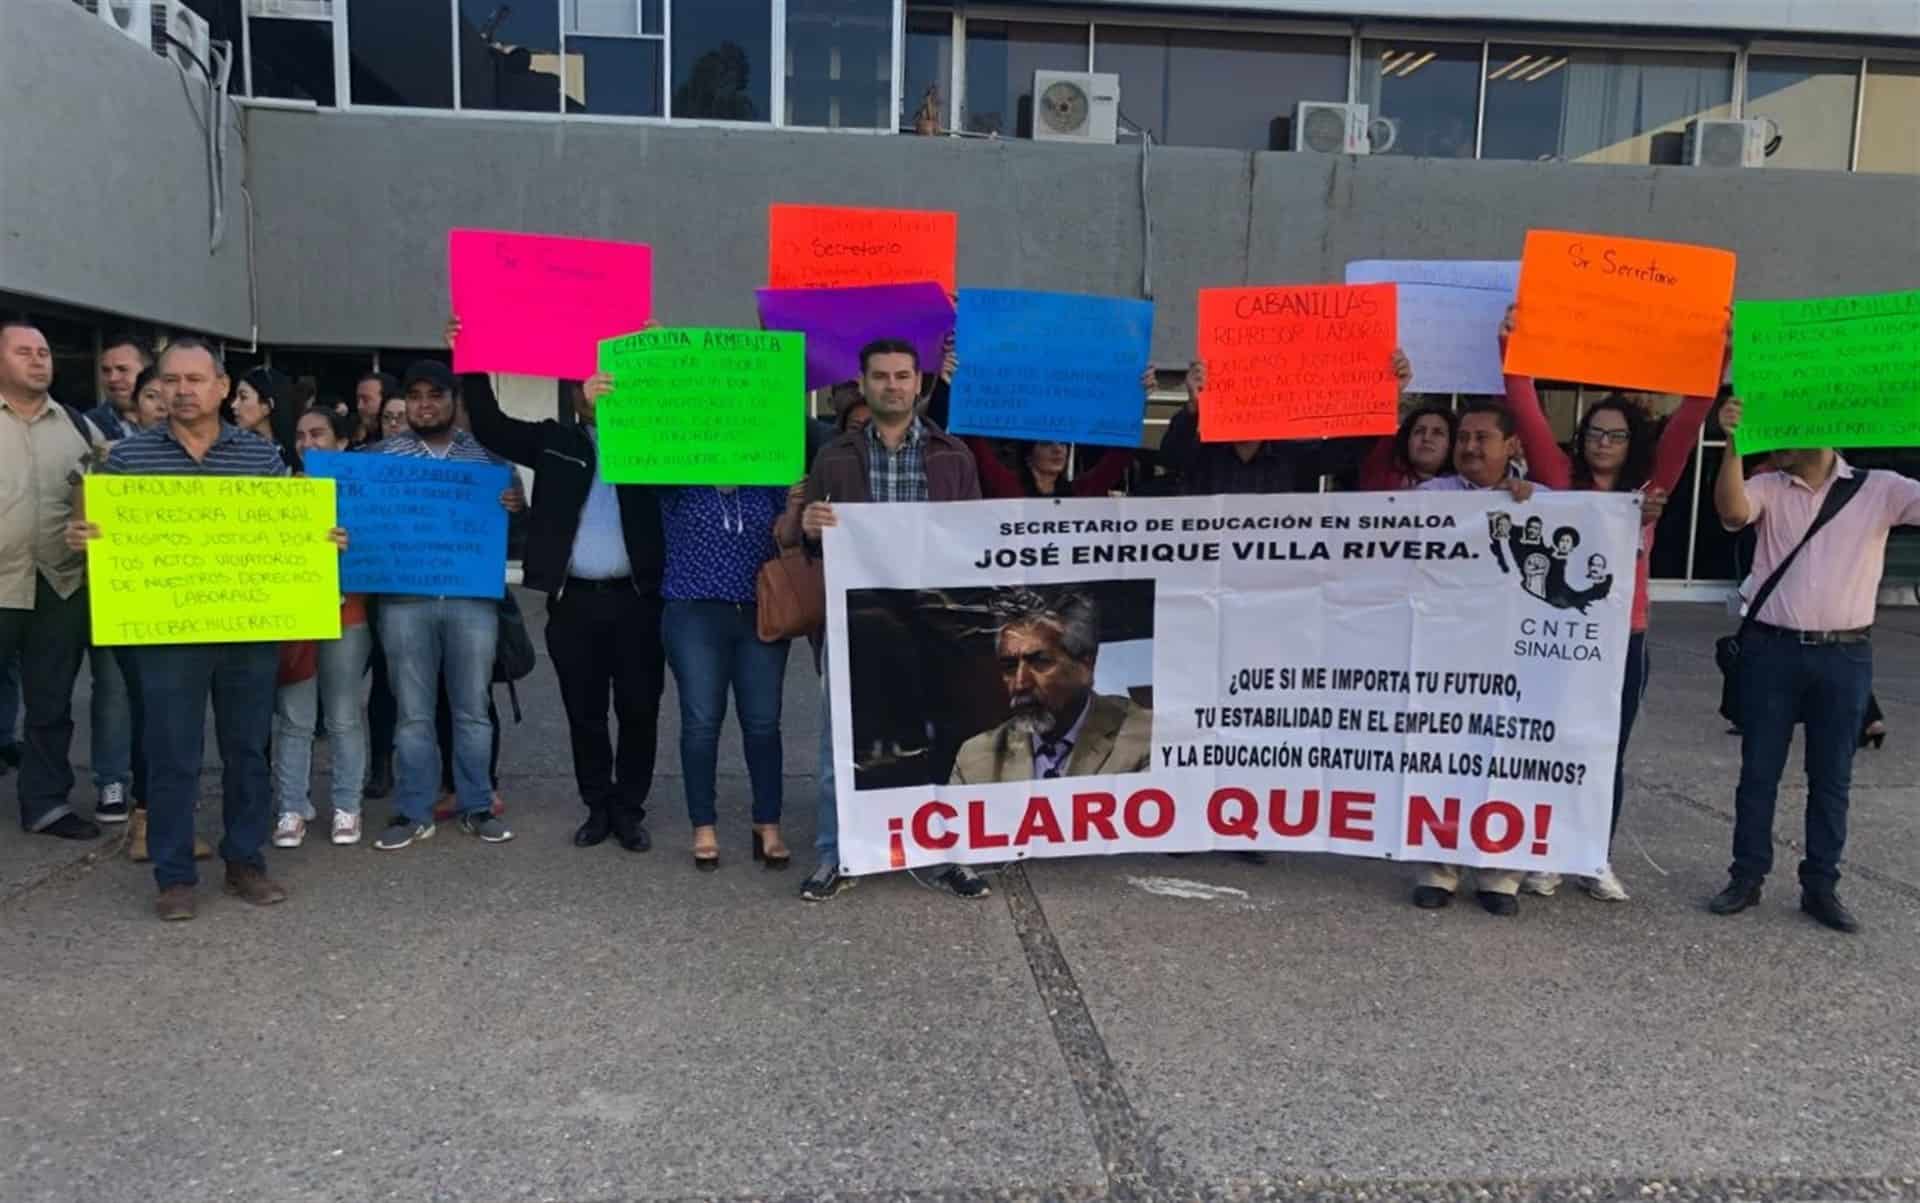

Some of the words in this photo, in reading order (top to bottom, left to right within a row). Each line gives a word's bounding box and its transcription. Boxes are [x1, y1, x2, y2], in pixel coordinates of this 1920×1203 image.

[1235, 289, 1378, 319] CABANILLAS
[106, 480, 206, 498] CAROLINA
[219, 480, 317, 498] ARMENTA
[116, 507, 226, 524] REPRESORA
[238, 507, 312, 523] LABORAL
[1000, 520, 1138, 535] SECRETARIO
[1146, 519, 1173, 532] DE
[1182, 515, 1313, 532] EDUCACIÓN
[1321, 516, 1350, 529] EN
[1359, 515, 1456, 529] SINALOA
[975, 543, 1059, 568] JOSÉ
[1072, 543, 1220, 564] ENRIQUE
[1232, 542, 1330, 560] VILLA
[1343, 540, 1479, 560] RIVERA.
[1514, 640, 1602, 661] SINALOA
[1229, 668, 1274, 695] ¿QUE
[1280, 668, 1296, 689] SI
[1302, 668, 1326, 689] ME
[1332, 669, 1410, 694] IMPORTA
[1416, 672, 1438, 693] TU
[1444, 672, 1521, 702] FUTURO,
[1195, 707, 1216, 728] TU
[1221, 707, 1332, 729] ESTABILIDAD
[1338, 708, 1362, 730] EN
[1368, 710, 1388, 732] EL
[1394, 712, 1463, 734] EMPLEO
[1468, 713, 1556, 742] MAESTRO
[1162, 746, 1172, 766] Y
[1178, 746, 1197, 766] LA
[1204, 743, 1303, 768] EDUCACIÓN
[1308, 747, 1395, 773] GRATUITA
[1400, 751, 1443, 774] PARA
[1448, 753, 1482, 776] LOS
[1487, 757, 1586, 785] ALUMNOS?
[889, 789, 1174, 869] ¡CLARO
[1208, 788, 1376, 839] QUE
[1408, 796, 1552, 854] NO!
